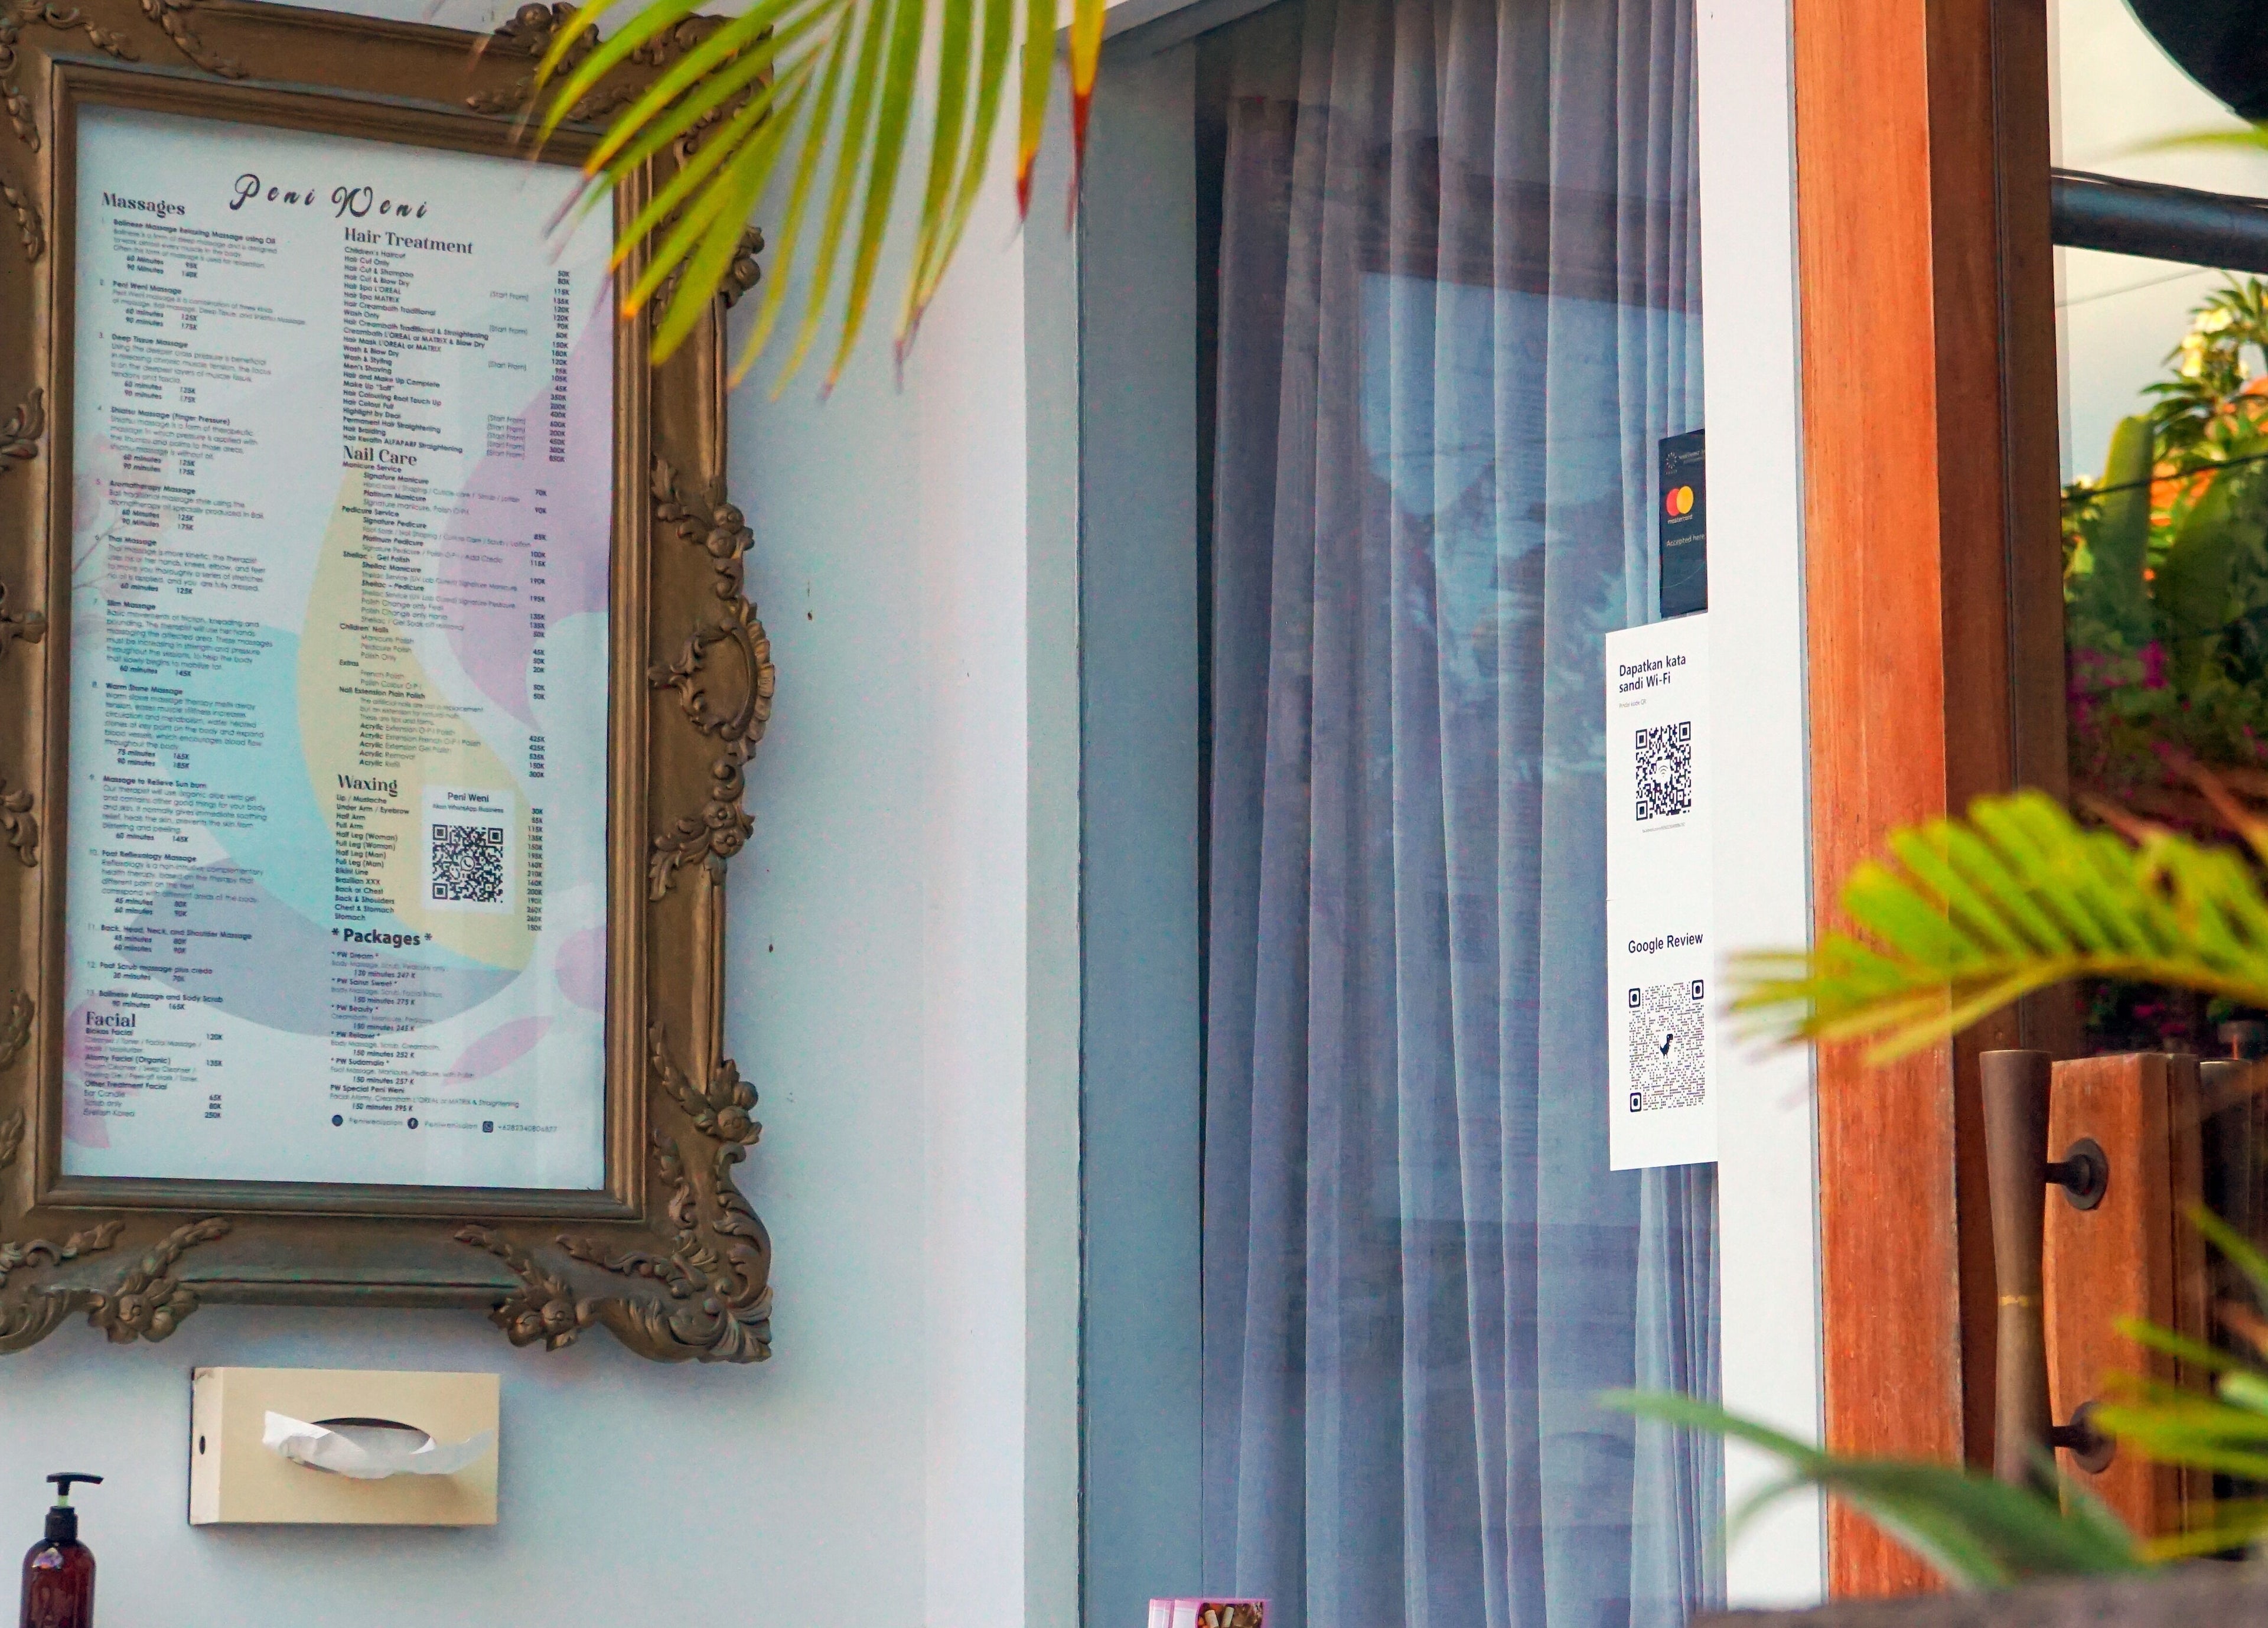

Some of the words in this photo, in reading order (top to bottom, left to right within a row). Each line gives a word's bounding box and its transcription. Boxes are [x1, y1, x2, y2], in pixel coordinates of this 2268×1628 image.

[229, 173, 315, 210] Peni
[331, 185, 428, 219] Weni
[102, 192, 185, 219] Massages
[345, 227, 381, 244] Hair
[384, 232, 472, 254] Treatment
[149, 284, 182, 295] Massage
[135, 309, 164, 318] minutes
[135, 318, 164, 327] minutes
[111, 333, 132, 343] Deep
[133, 335, 154, 344] Tissue
[155, 338, 188, 349] Massage
[137, 409, 170, 420] Massage
[343, 445, 374, 461] Nail
[378, 449, 417, 465] Care
[342, 461, 375, 470] Manicure
[376, 464, 402, 473] Service
[363, 471, 396, 481] Signature
[397, 476, 429, 485] Manicure
[163, 485, 196, 496] Massage
[341, 505, 372, 515] Pedicure
[374, 508, 399, 517] Service
[363, 516, 395, 526] Signature
[396, 520, 427, 529] Pedicure
[1667, 514, 1693, 525] mastercard
[1666, 535, 1692, 547] Accepted
[389, 564, 422, 573] Manicure
[1619, 659, 1663, 678] Dapatkan
[1666, 655, 1686, 668] kata
[1619, 677, 1643, 693] sandi
[1646, 672, 1671, 688] Wi-Fi
[150, 686, 183, 696] Massage
[103, 776, 136, 785] Massage
[337, 774, 398, 797] Waxing
[447, 792, 466, 801] Peni
[468, 793, 489, 802] Weni
[351, 832, 364, 841] Leg
[164, 854, 197, 863] Massage
[350, 850, 364, 858] Leg
[348, 859, 361, 868] Leg
[343, 927, 421, 948] Packages
[1628, 937, 1664, 954] Google
[1667, 933, 1703, 948] Review
[86, 1011, 136, 1027] Facial
